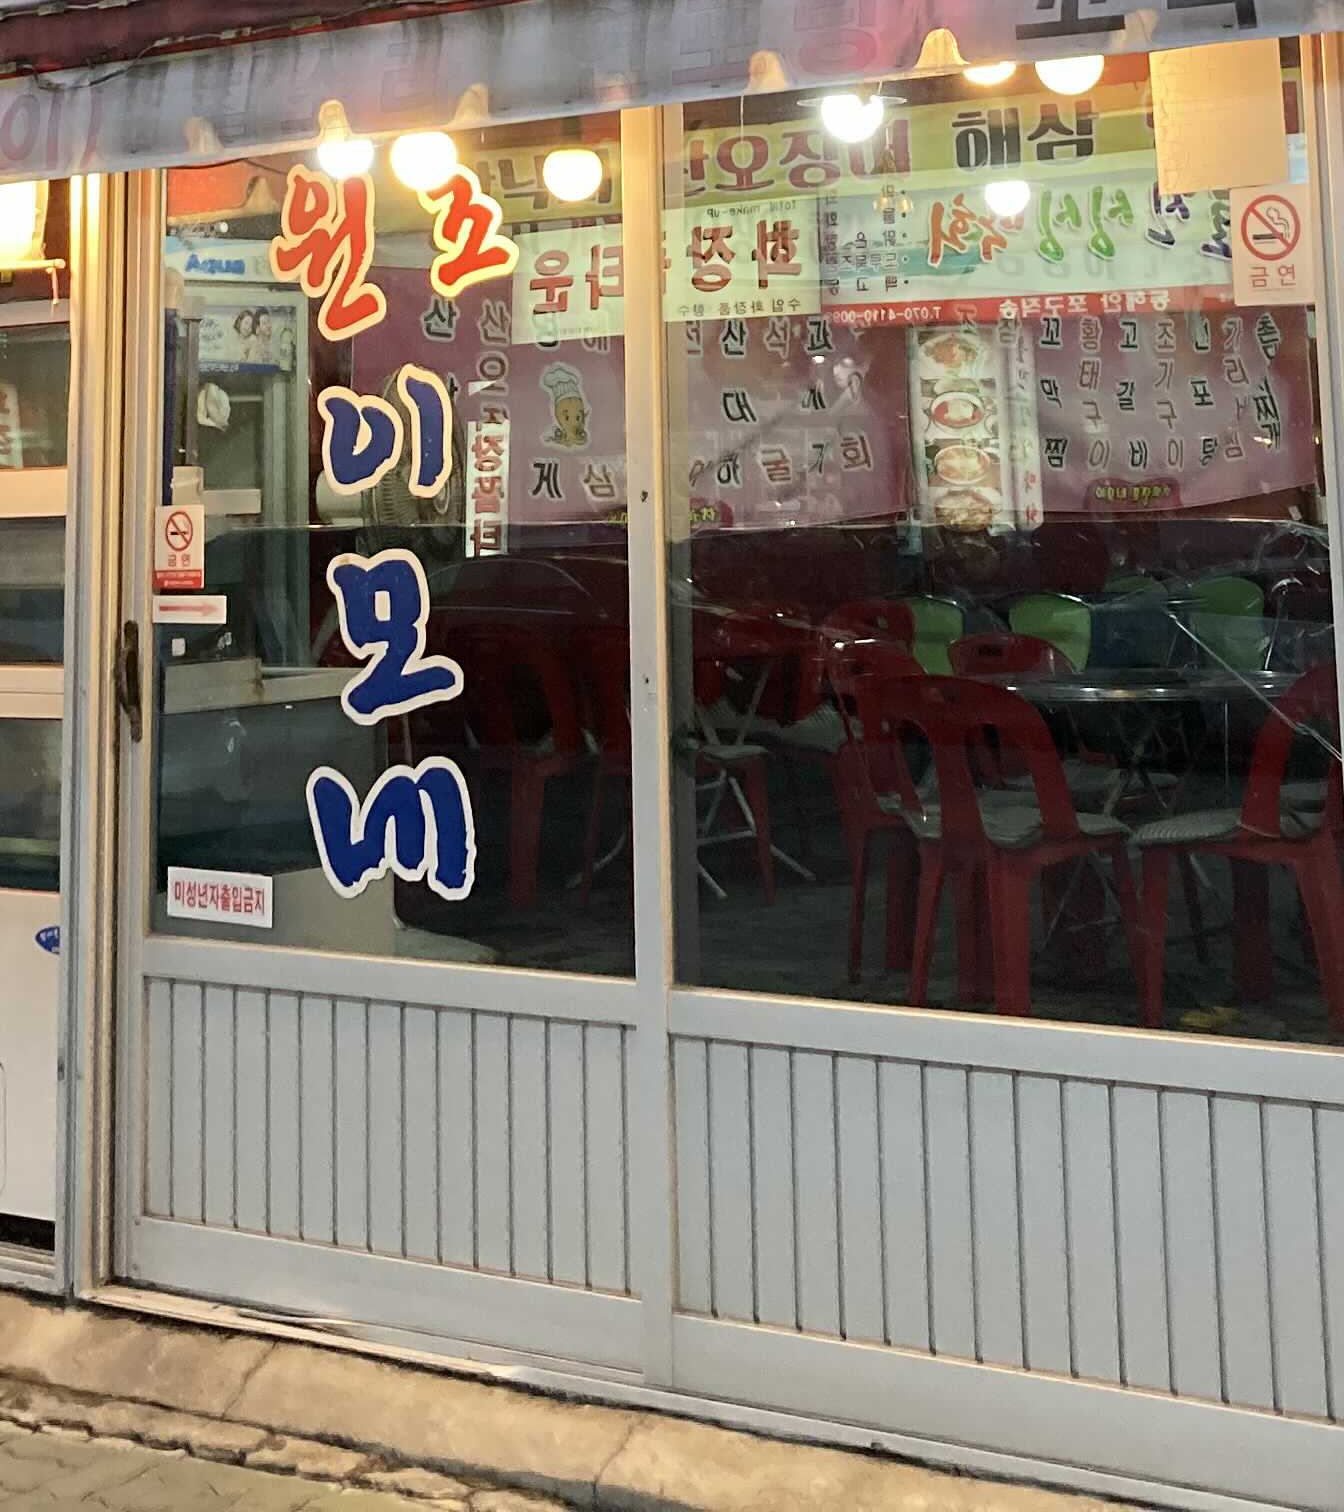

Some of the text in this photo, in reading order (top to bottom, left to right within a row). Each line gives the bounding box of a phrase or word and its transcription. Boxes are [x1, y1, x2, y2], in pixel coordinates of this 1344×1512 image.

[950, 98, 1100, 172] 해삼
[268, 163, 520, 341] 원조
[173, 880, 266, 915] 미성년자출입금지
